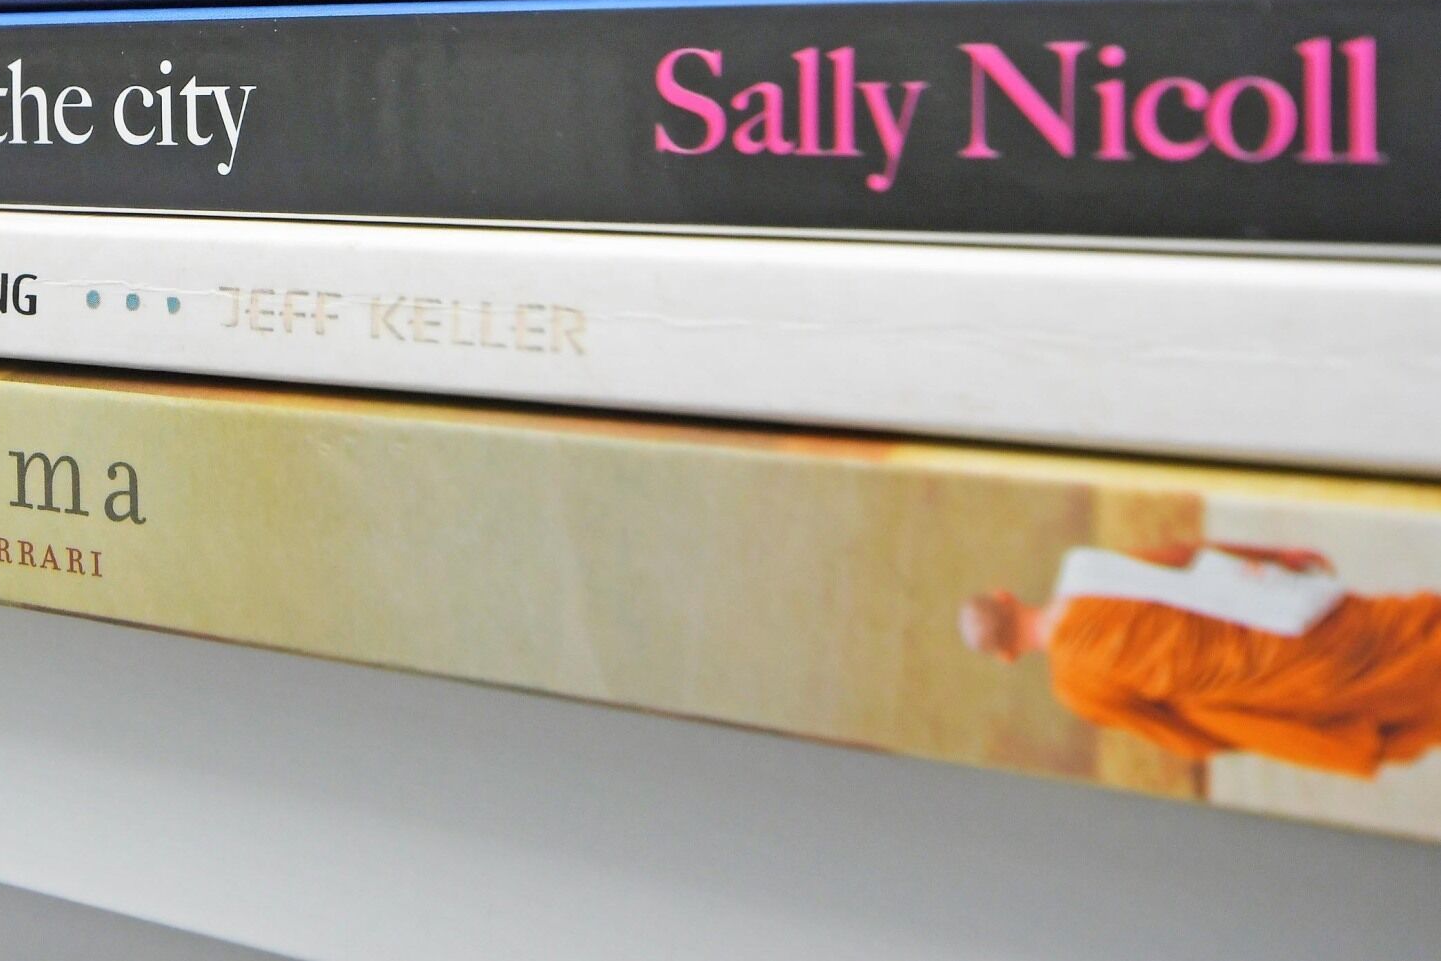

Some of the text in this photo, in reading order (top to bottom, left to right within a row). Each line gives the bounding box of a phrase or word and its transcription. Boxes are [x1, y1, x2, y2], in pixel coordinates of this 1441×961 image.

[113, 59, 257, 176] city
[654, 36, 1389, 193] Sally Nicoll
[218, 285, 587, 356] JEFF KELLER
